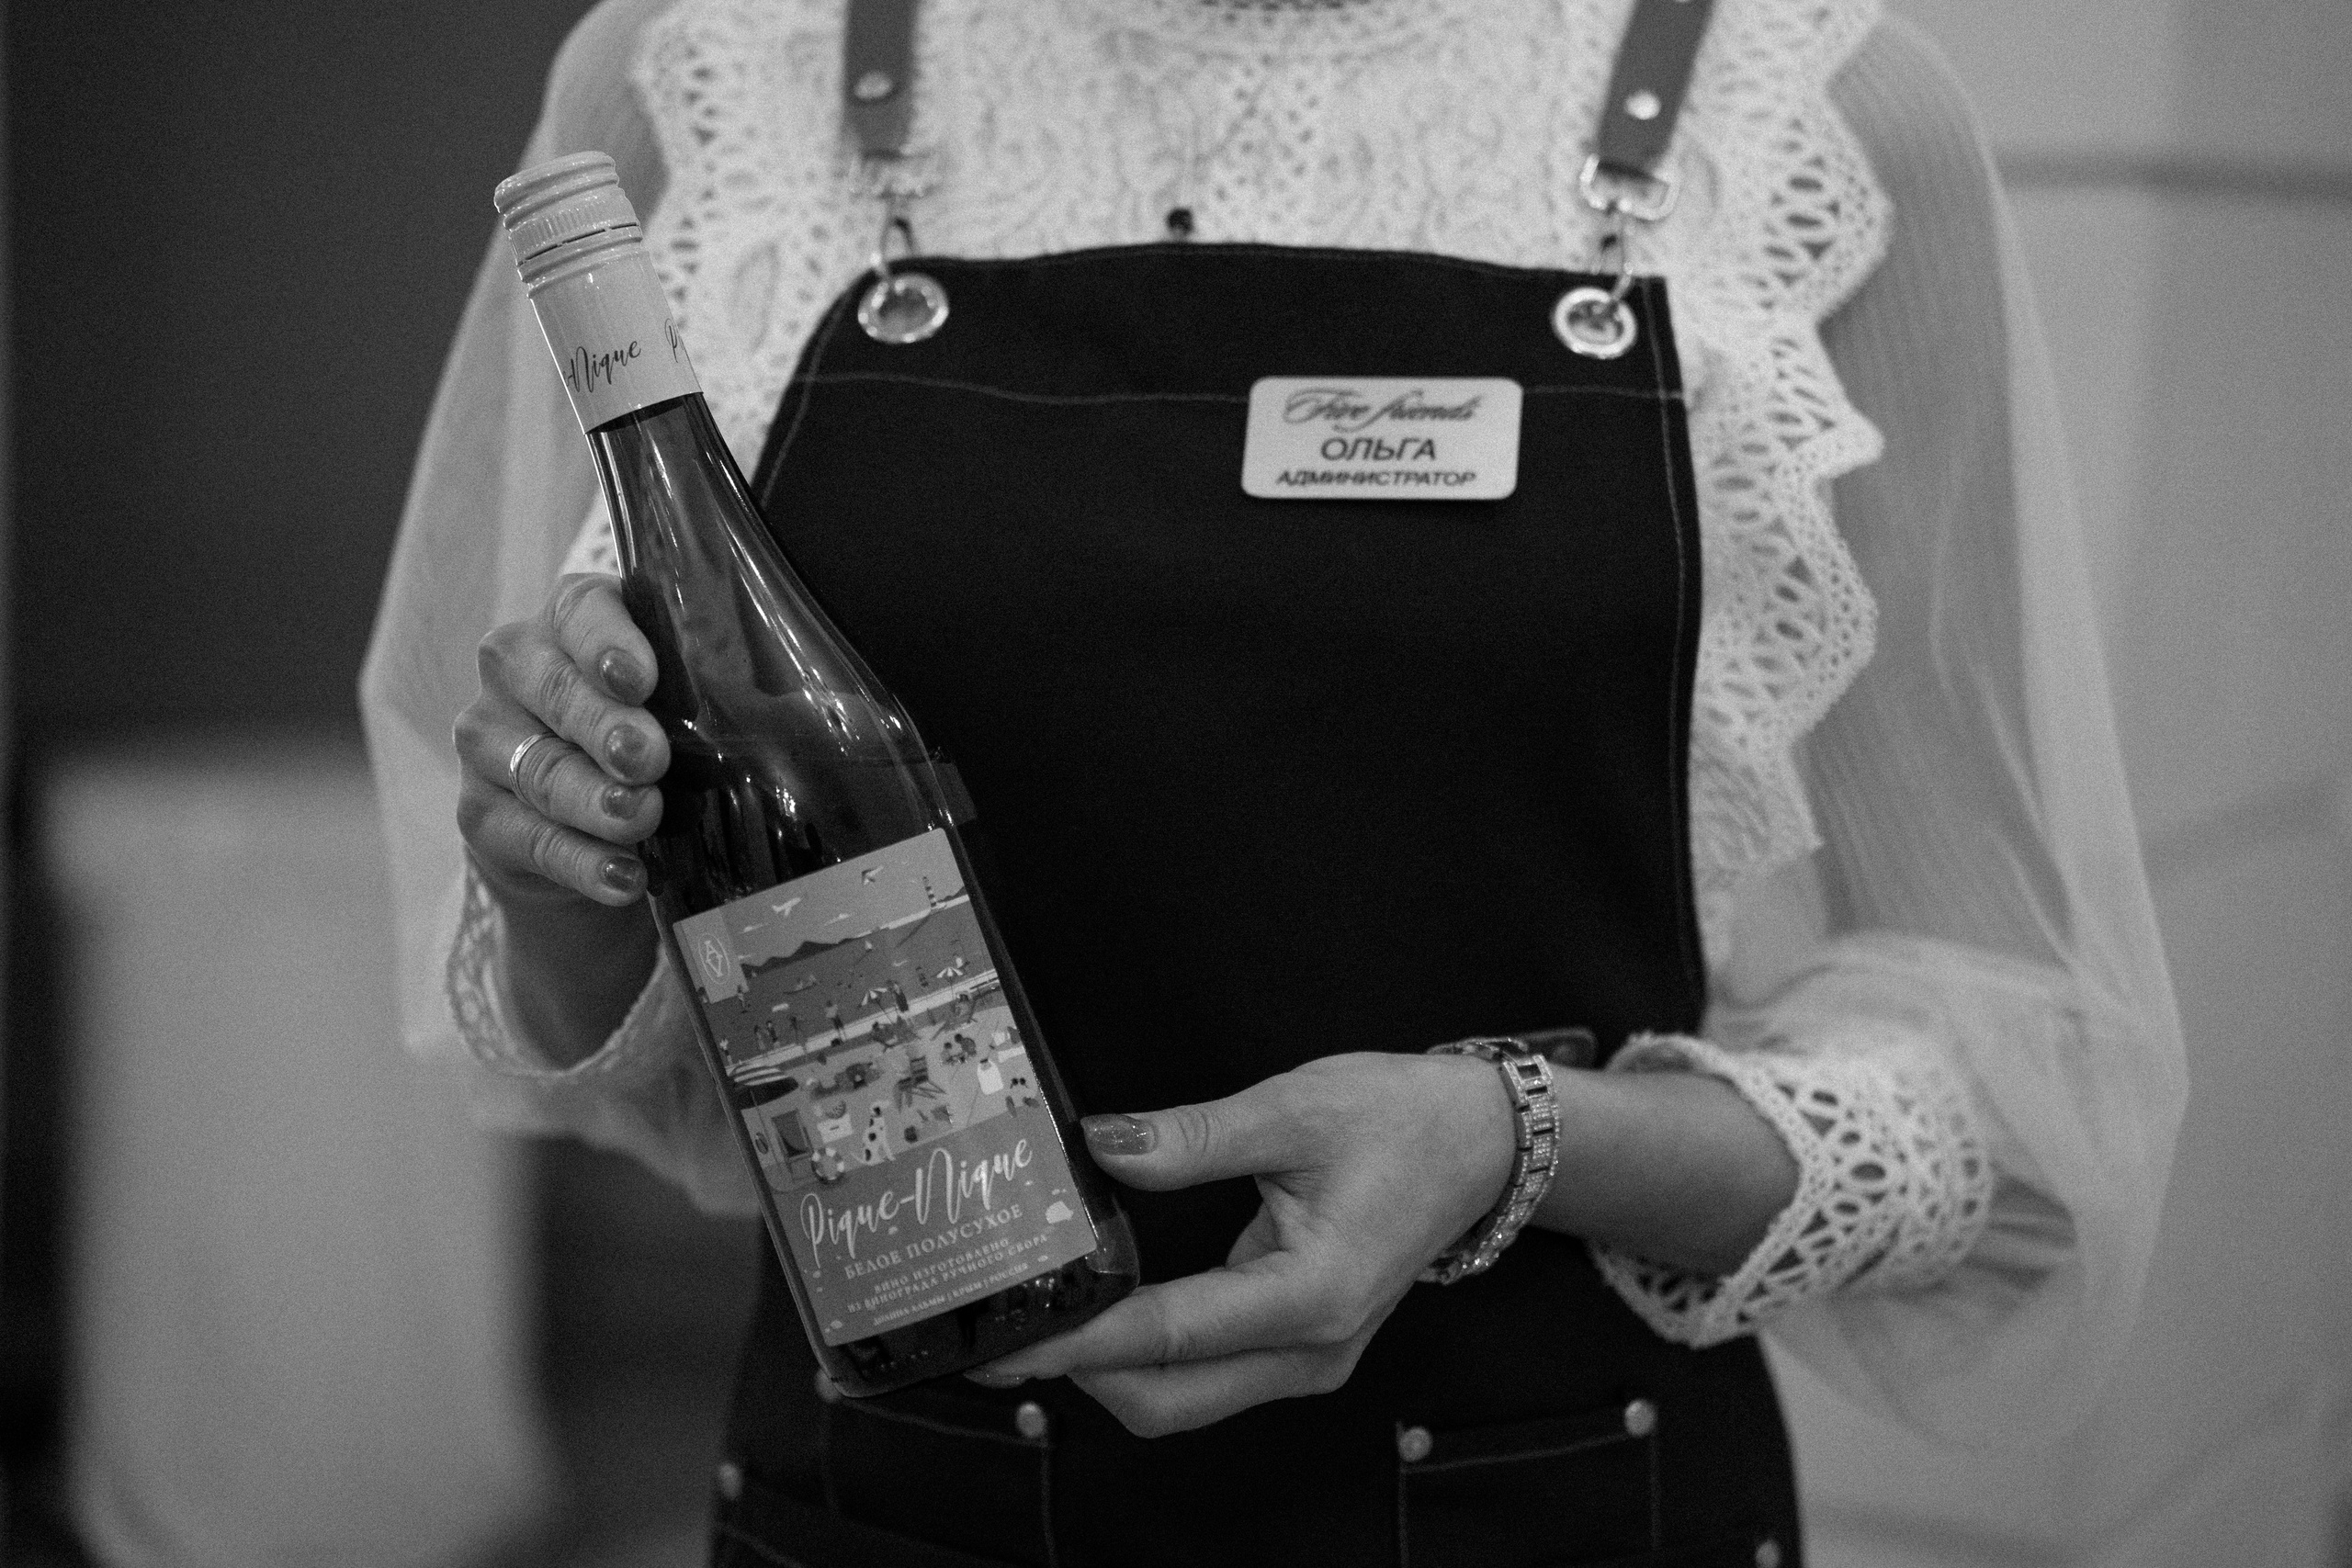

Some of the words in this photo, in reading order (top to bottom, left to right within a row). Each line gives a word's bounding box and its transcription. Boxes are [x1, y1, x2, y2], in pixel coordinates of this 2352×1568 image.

[1276, 468, 1476, 487] АДМИНИСТРАТОР
[1320, 437, 1436, 461] ОЛЬГА
[844, 1249, 902, 1280] БЕЛОЕ
[906, 1203, 1024, 1259] ПОЛУСУХОЕ
[874, 1275, 909, 1294] ВИНО
[912, 1237, 1010, 1281] ИЗГОТОВЛЕНО
[864, 1276, 938, 1311] ВИНОГРАДА
[942, 1250, 1004, 1282] РУЧНОГО
[1008, 1234, 1048, 1257] СБОРА
